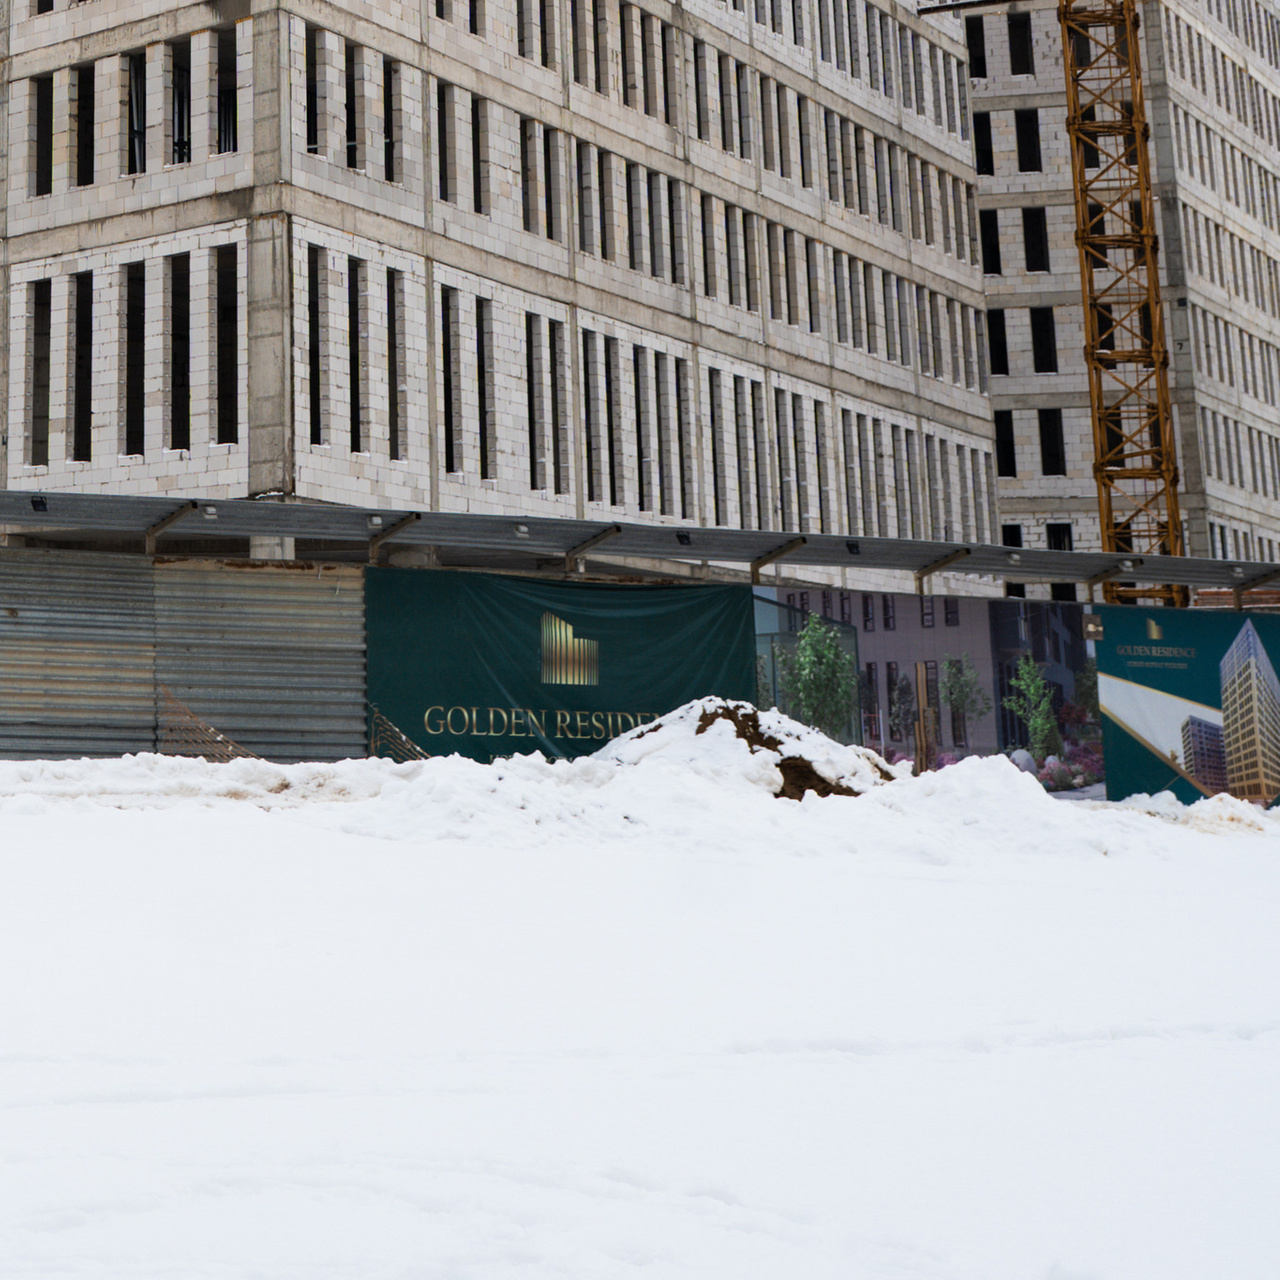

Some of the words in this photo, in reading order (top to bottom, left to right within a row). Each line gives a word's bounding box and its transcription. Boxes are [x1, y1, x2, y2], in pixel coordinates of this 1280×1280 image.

[1116, 645, 1150, 657] GOLDEN
[1151, 646, 1196, 659] RESIDENCE
[424, 705, 548, 738] GOLDEN
[554, 710, 662, 740] RESIDE
